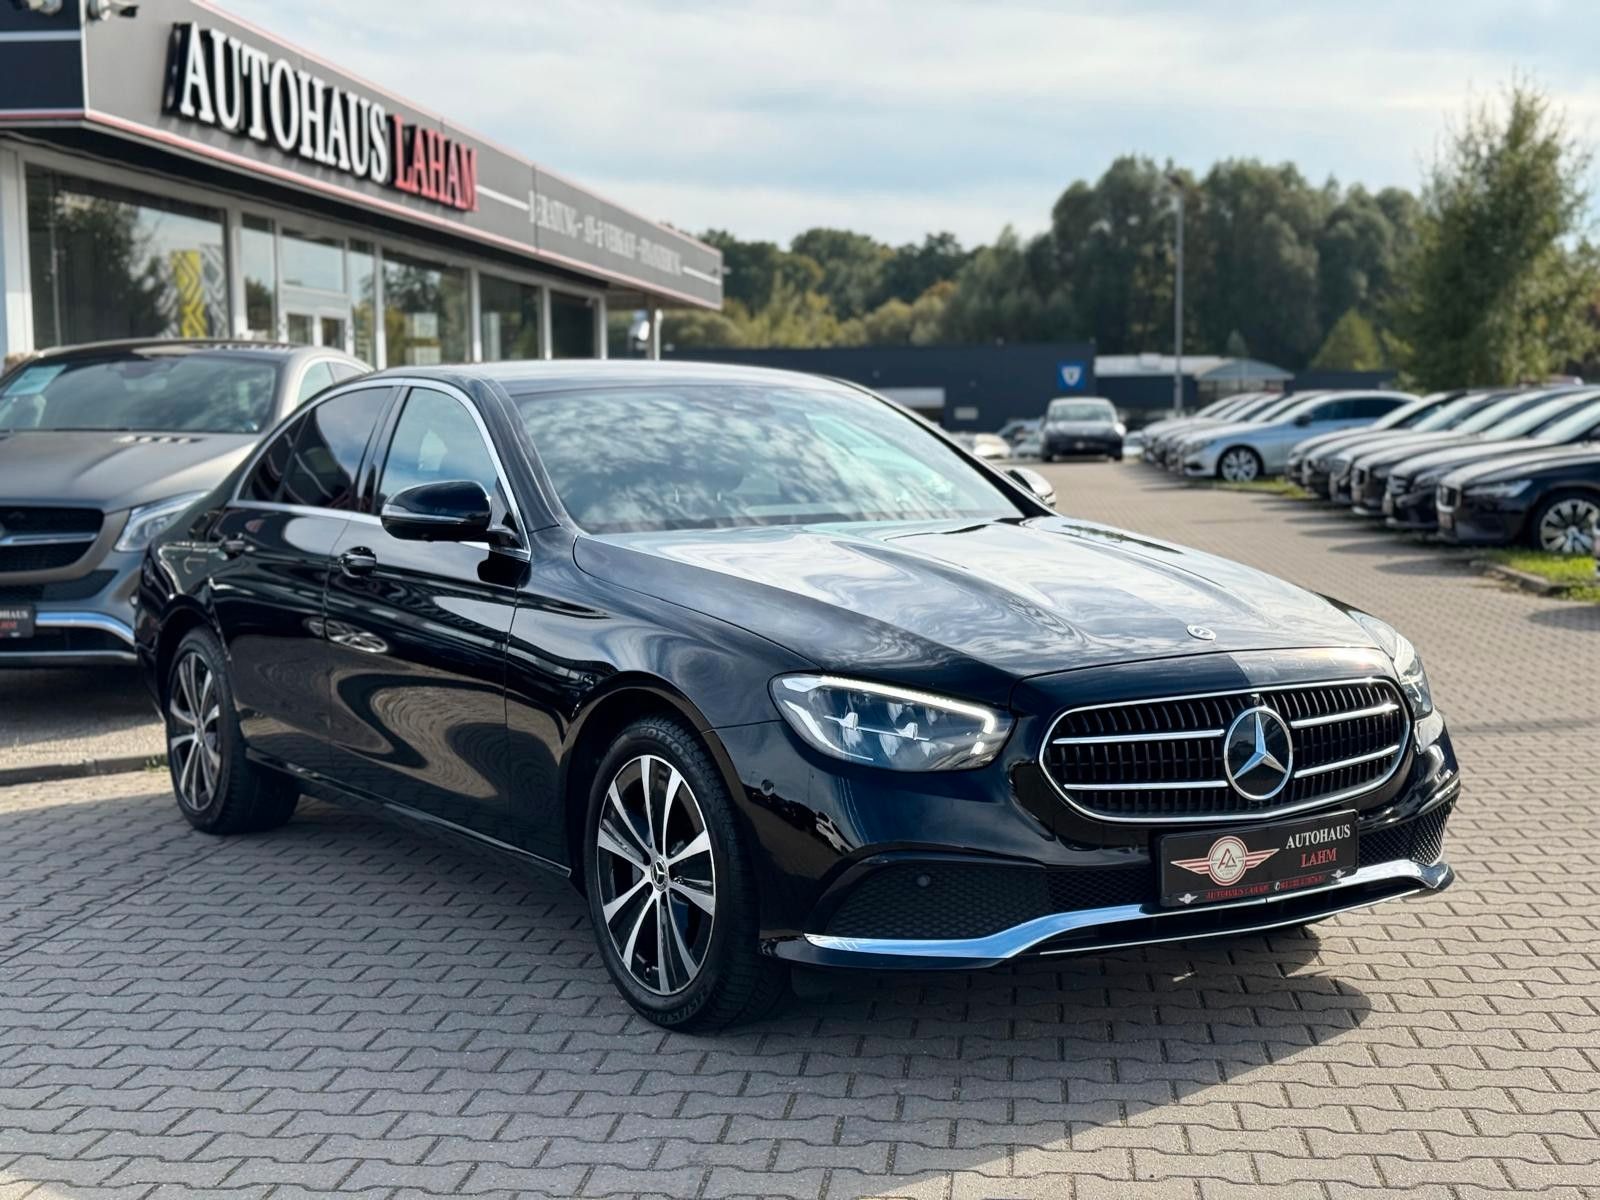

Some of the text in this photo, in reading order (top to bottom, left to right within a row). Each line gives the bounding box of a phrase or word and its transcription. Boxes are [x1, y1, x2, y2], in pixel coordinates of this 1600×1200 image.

[180, 21, 389, 184] AUTOHAUS
[1286, 824, 1351, 849] AUTOHAUS
[1301, 848, 1337, 867] LAHM
